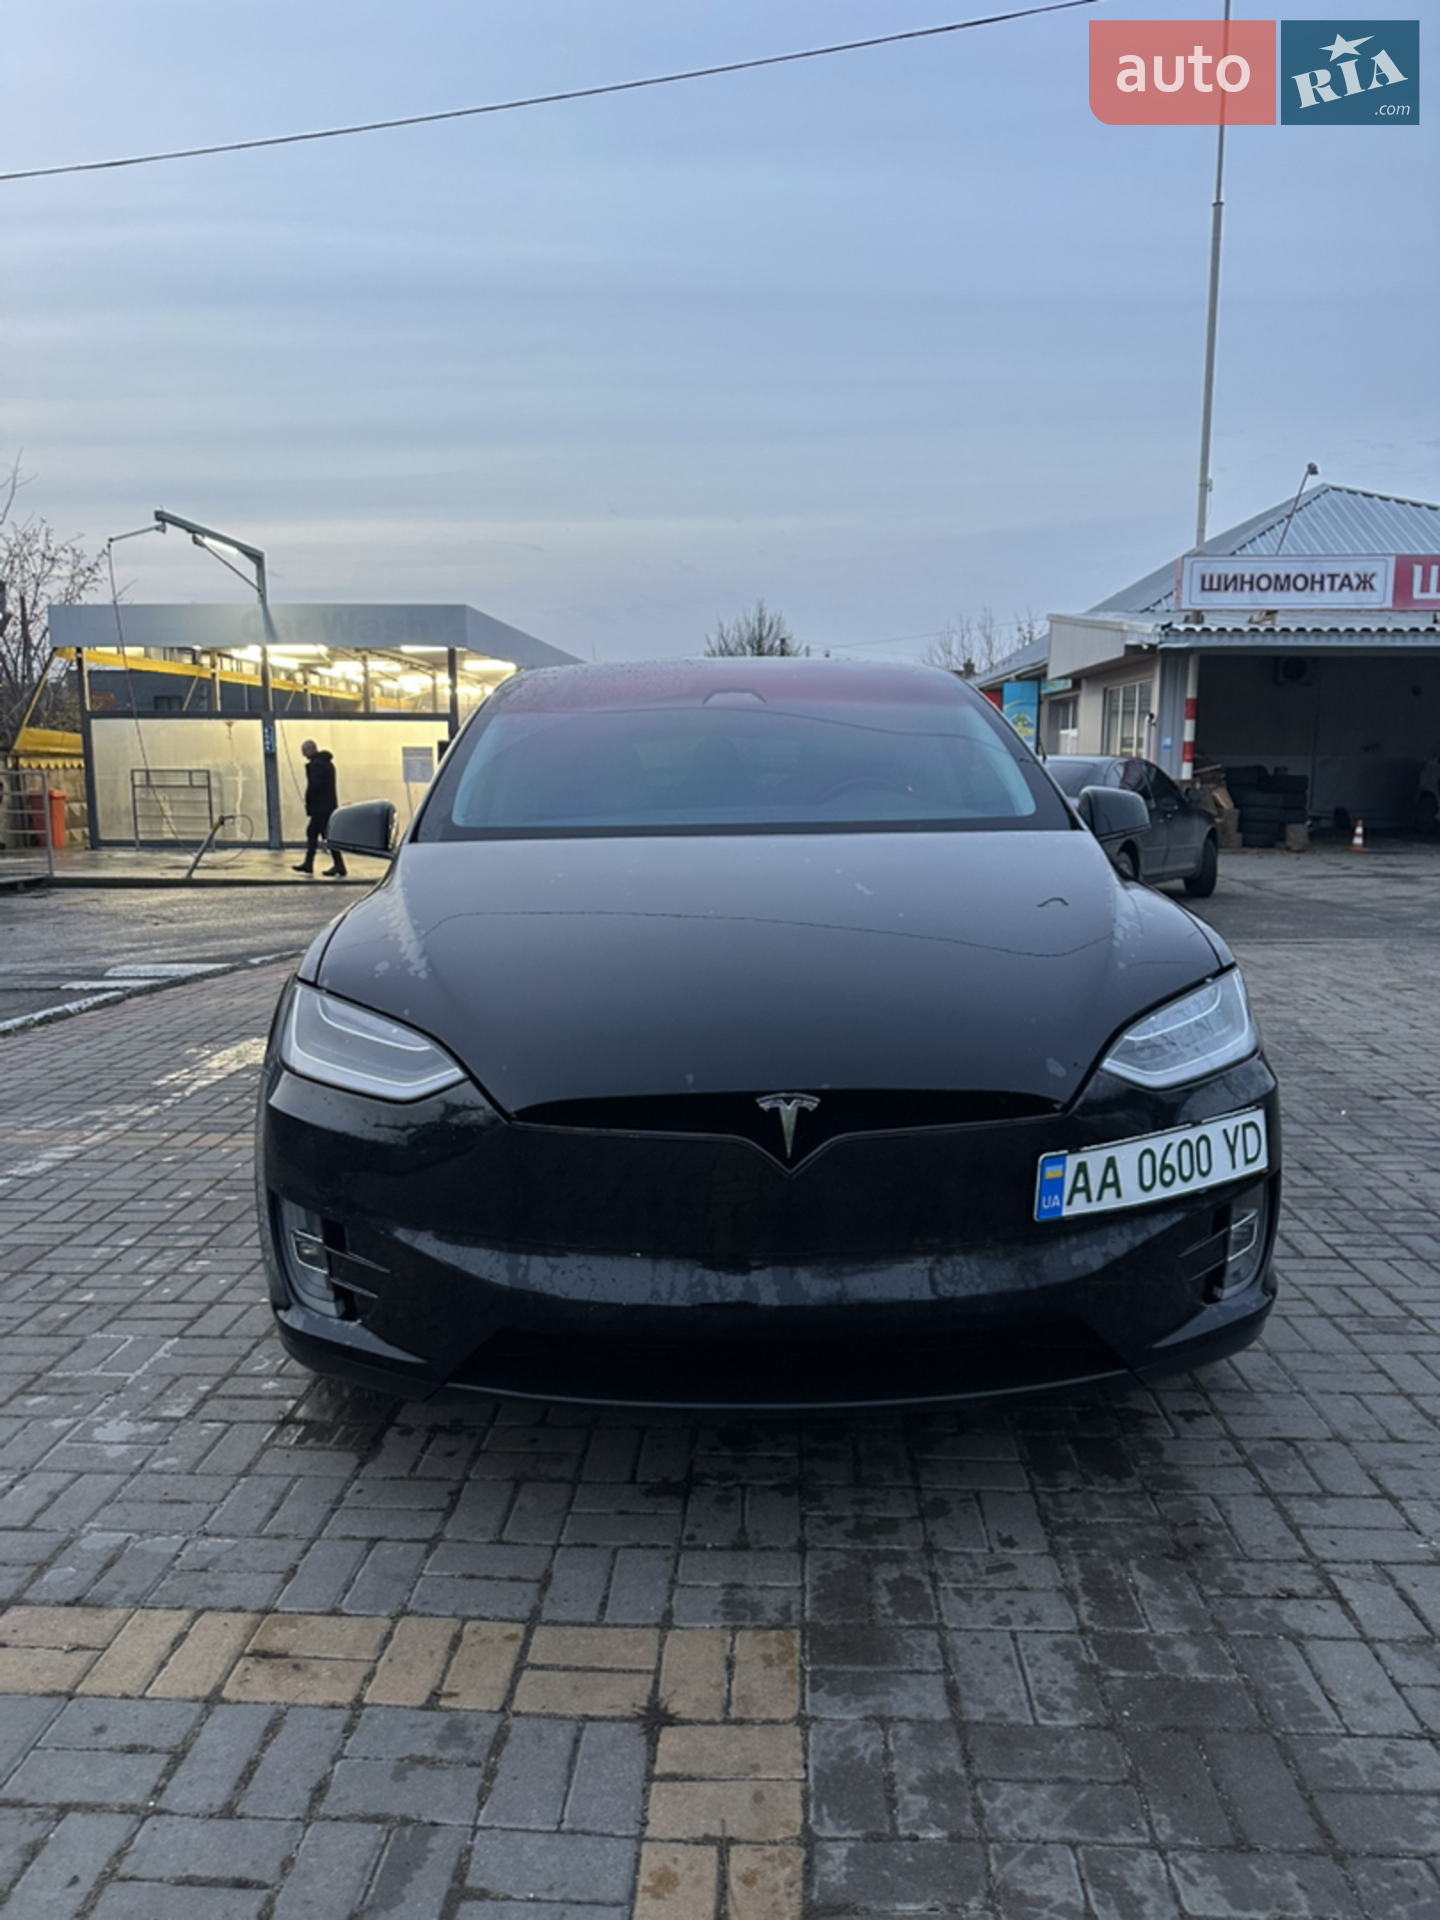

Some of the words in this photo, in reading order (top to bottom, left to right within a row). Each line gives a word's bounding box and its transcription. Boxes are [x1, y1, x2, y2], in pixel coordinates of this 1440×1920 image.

[1200, 572, 1377, 593] ШИНОМОНТАЖ
[319, 608, 430, 641] Wash
[1065, 1155, 1123, 1207] AA
[1137, 1133, 1213, 1193] 0600
[1222, 1120, 1262, 1171] YD
[1041, 1194, 1061, 1210] UA
